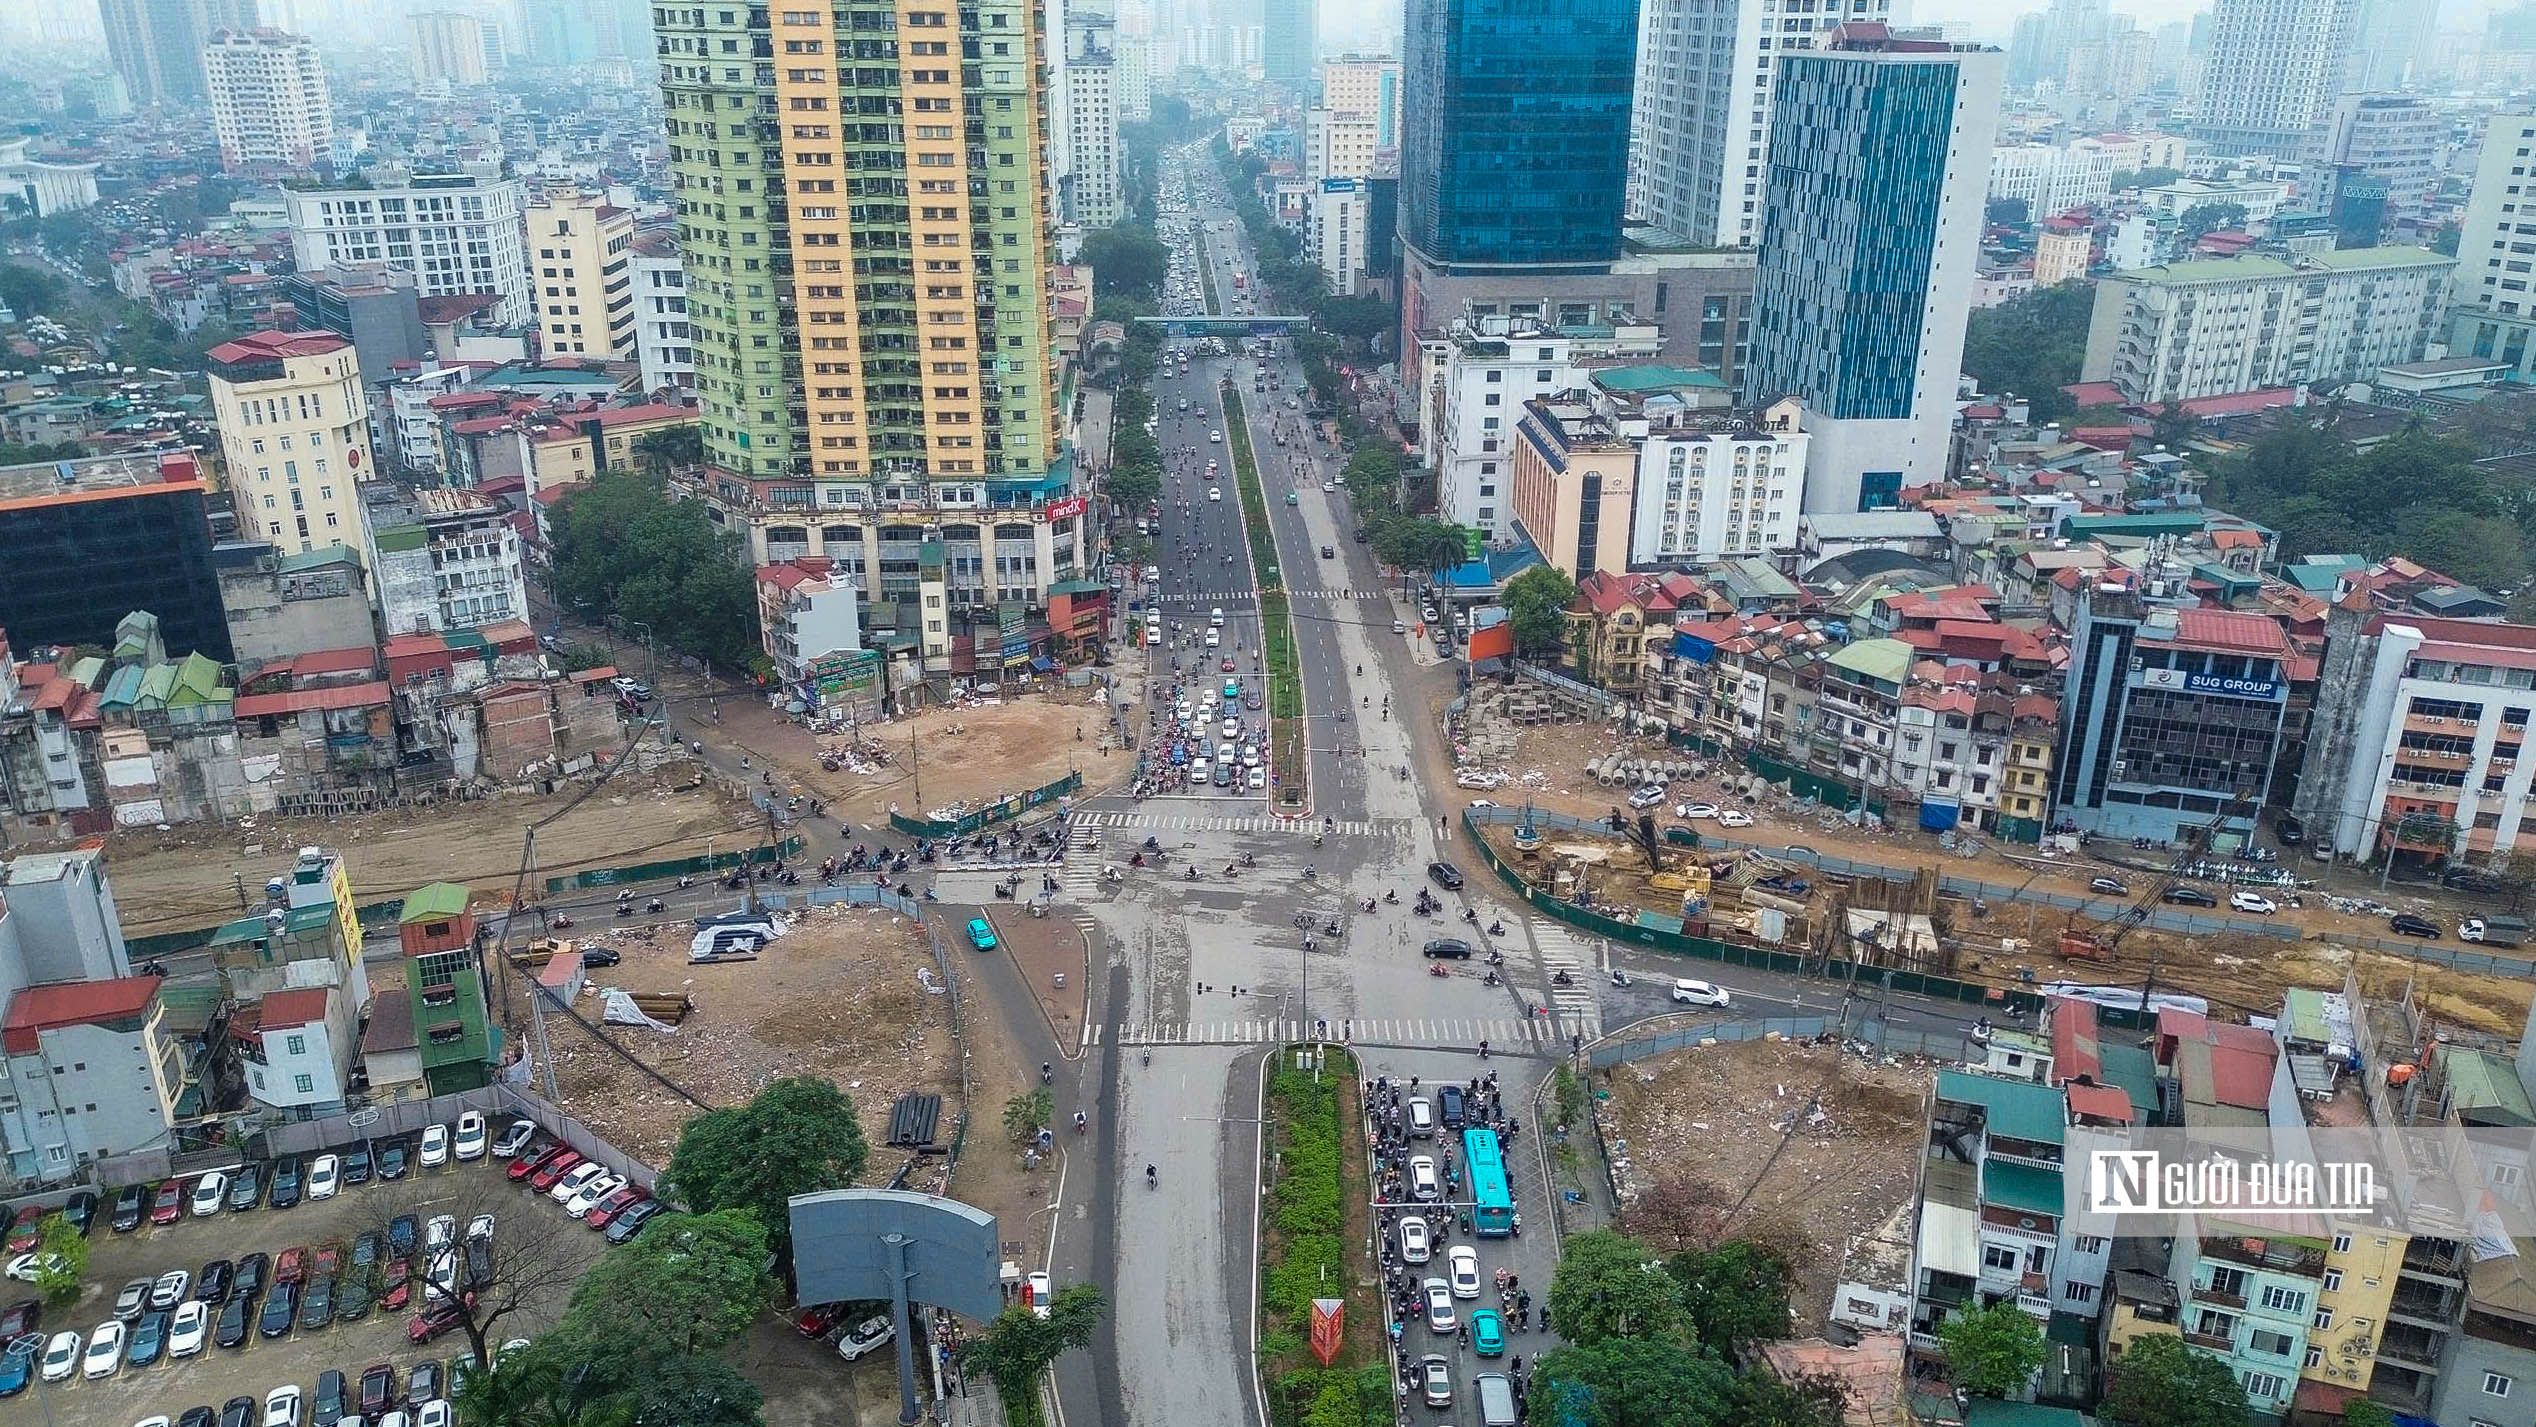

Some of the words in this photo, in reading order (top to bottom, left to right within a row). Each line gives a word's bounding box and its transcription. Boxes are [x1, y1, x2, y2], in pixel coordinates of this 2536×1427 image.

[1053, 500, 1080, 518] mindX
[2192, 676, 2220, 688] SUG
[2224, 679, 2272, 693] GROUP
